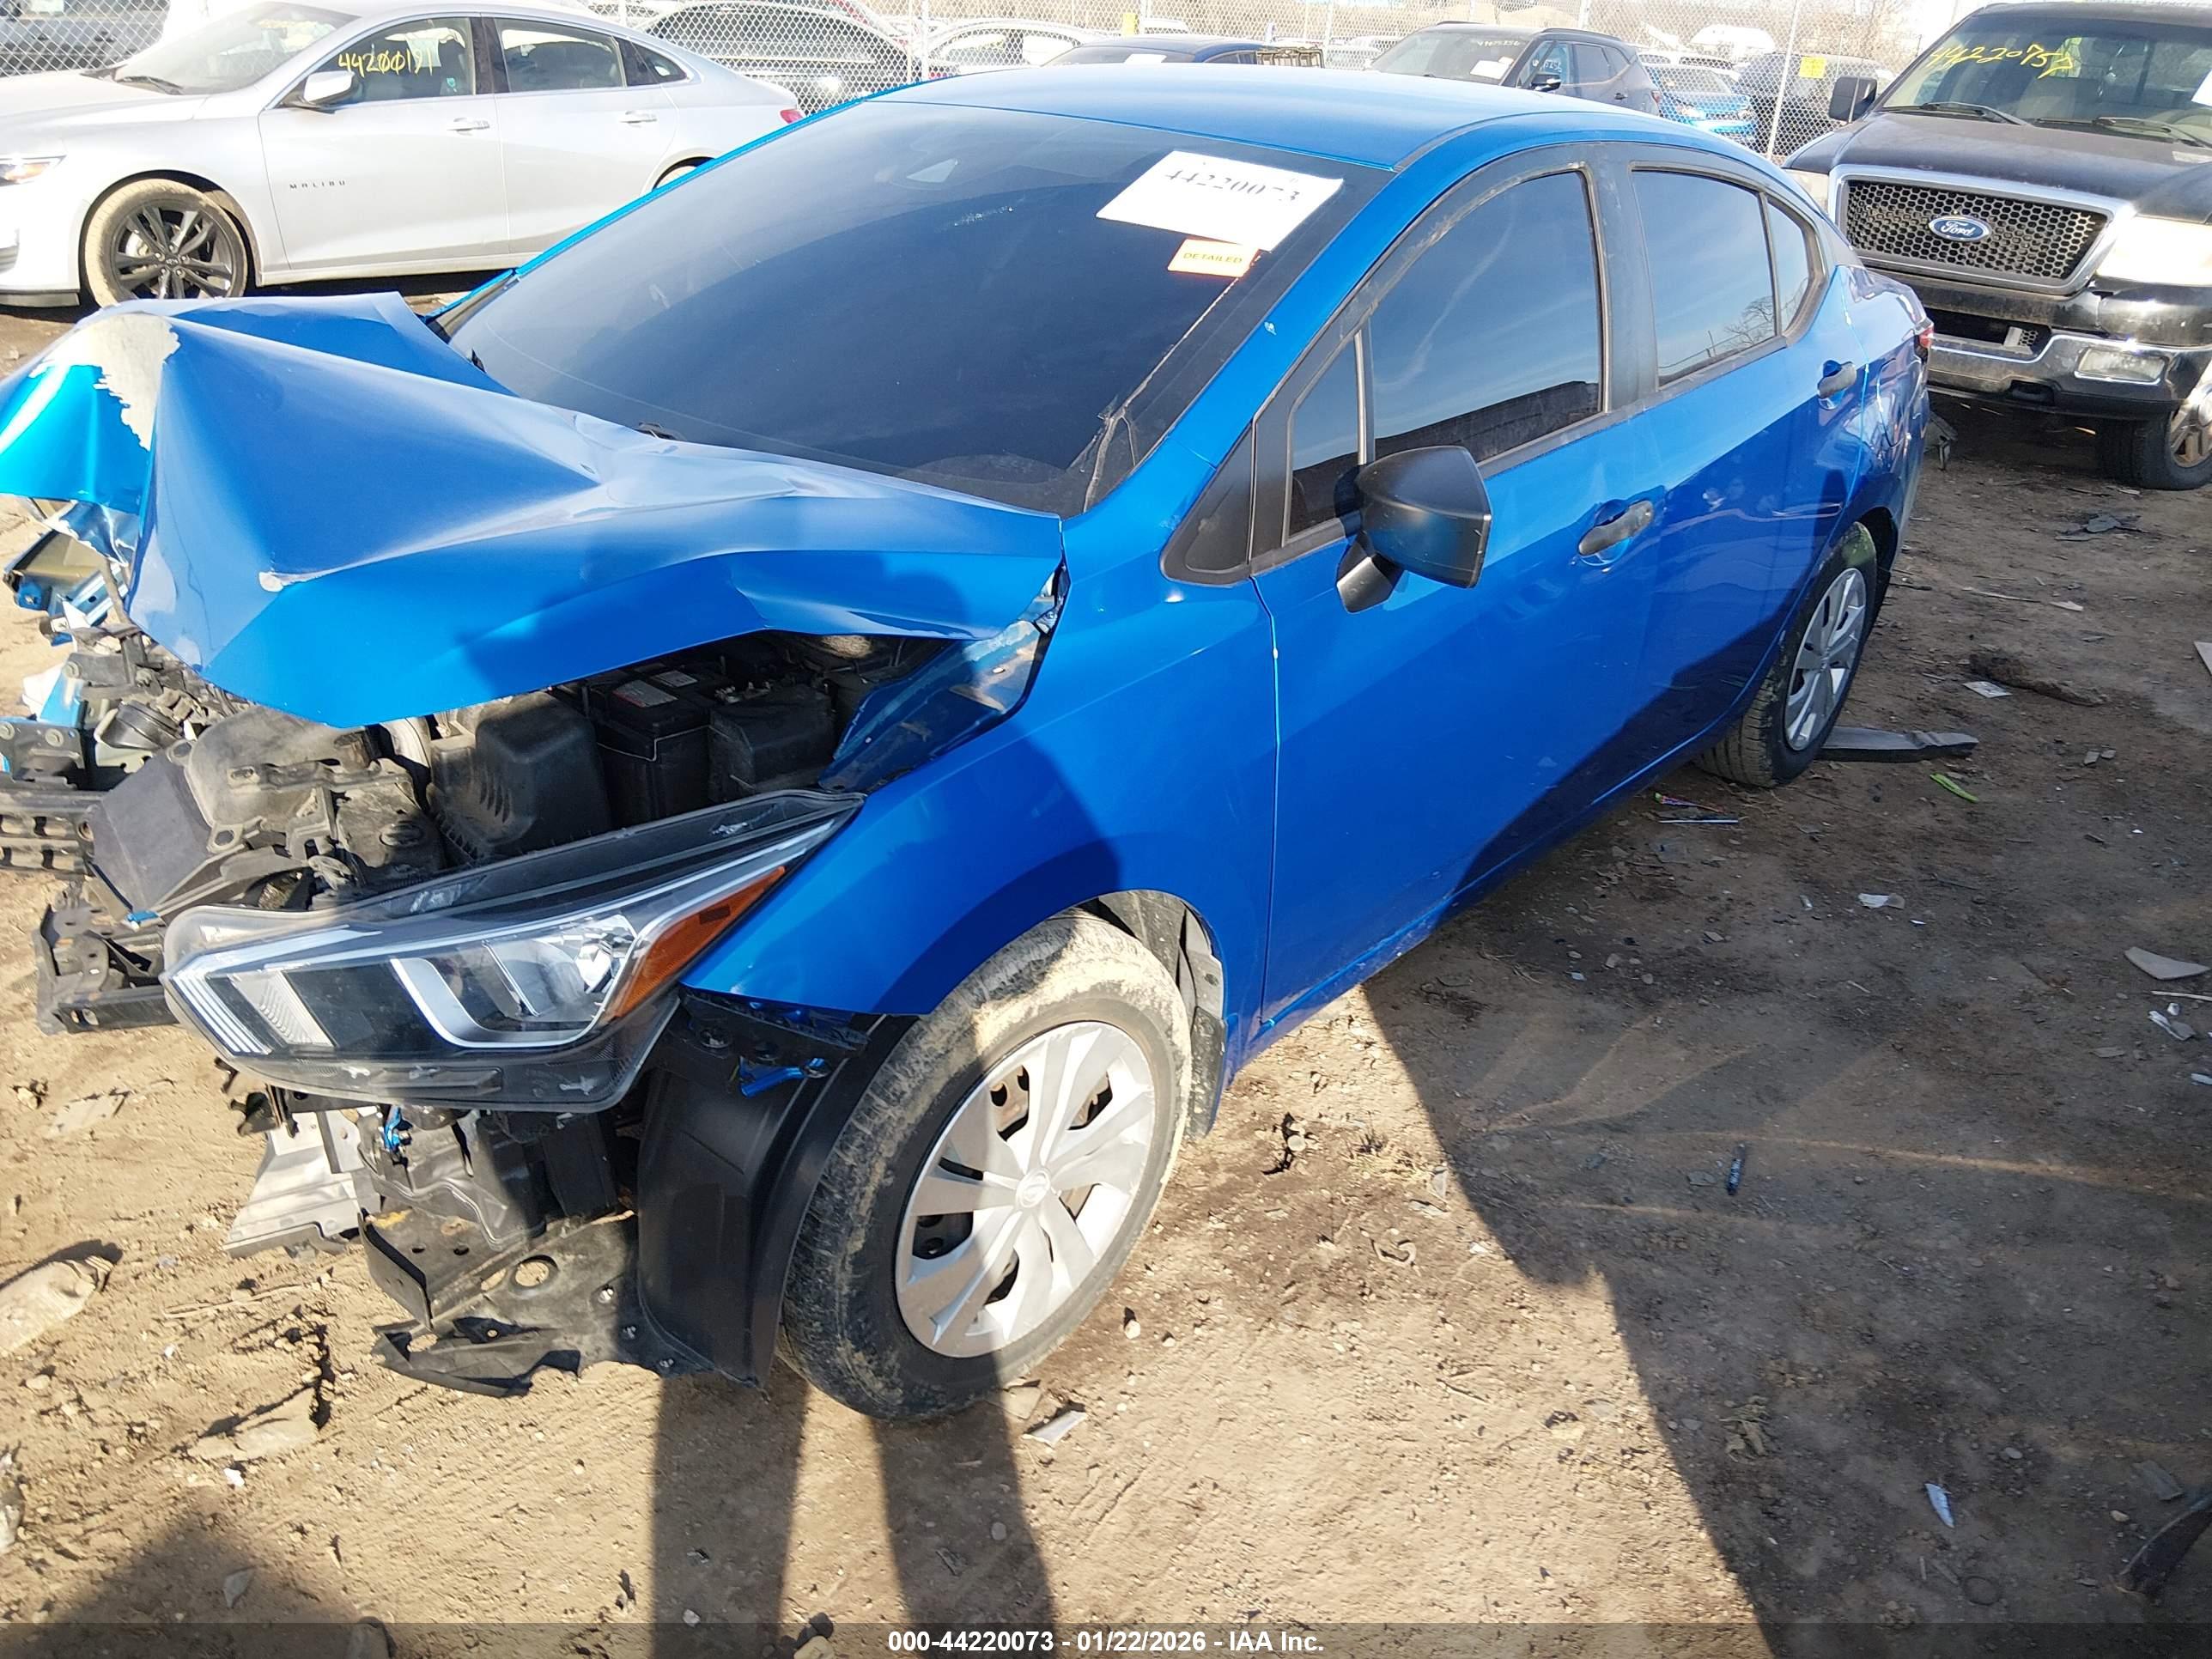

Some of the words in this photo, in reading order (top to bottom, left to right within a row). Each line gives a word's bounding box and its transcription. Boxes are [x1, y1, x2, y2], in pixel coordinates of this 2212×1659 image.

[338, 49, 433, 77] 44200191
[289, 180, 345, 189] MALIBU
[1941, 220, 1976, 236] Ford
[1183, 252, 1243, 264] DETAILED
